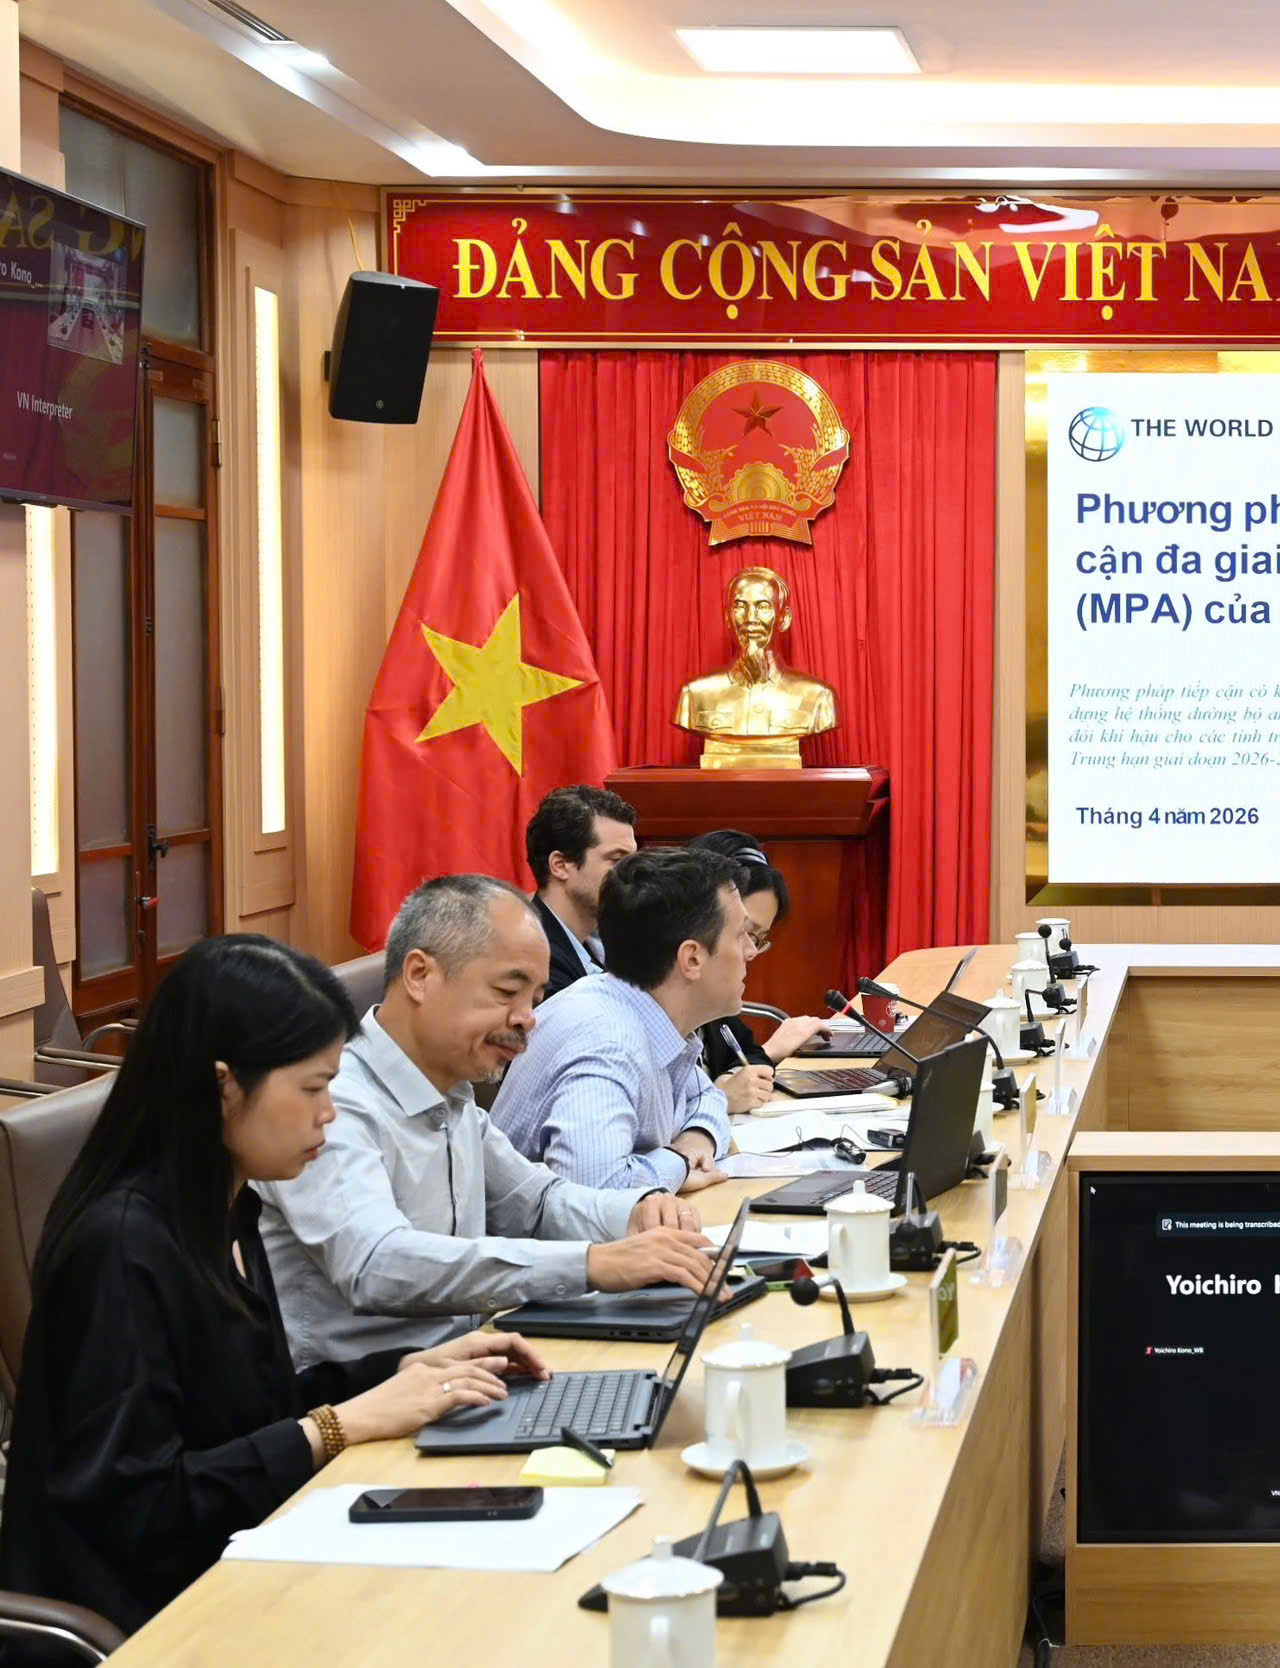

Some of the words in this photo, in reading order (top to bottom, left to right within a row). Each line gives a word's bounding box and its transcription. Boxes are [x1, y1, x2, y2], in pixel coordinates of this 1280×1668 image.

[453, 217, 639, 300] ĐẢNG
[660, 222, 851, 320] CỘNG
[870, 219, 991, 301] SẢN
[1012, 224, 1167, 320] VIỆT
[17, 391, 30, 409] VN
[31, 395, 73, 421] Interpreter
[1131, 418, 1176, 437] THE
[1184, 418, 1274, 437] WORLD
[1076, 493, 1232, 532] Phương
[1076, 544, 1143, 580] cận
[1156, 543, 1202, 575] đa
[1076, 593, 1192, 631] (MPA)
[1204, 592, 1271, 624] của
[1069, 683, 1130, 700] Phương
[1135, 683, 1175, 701] pháp
[1165, 729, 1192, 743] cho
[1071, 751, 1116, 768] Trung
[1154, 752, 1184, 769] giai
[1076, 807, 1143, 829] Tháng
[1149, 808, 1160, 824] 4
[1165, 808, 1206, 824] năm
[1210, 808, 1260, 825] 2026
[1175, 1221, 1189, 1229] This
[1189, 1221, 1217, 1230] meeting
[1218, 1221, 1224, 1229] is
[1225, 1221, 1244, 1230] being
[1165, 1273, 1262, 1295] Yoichiro
